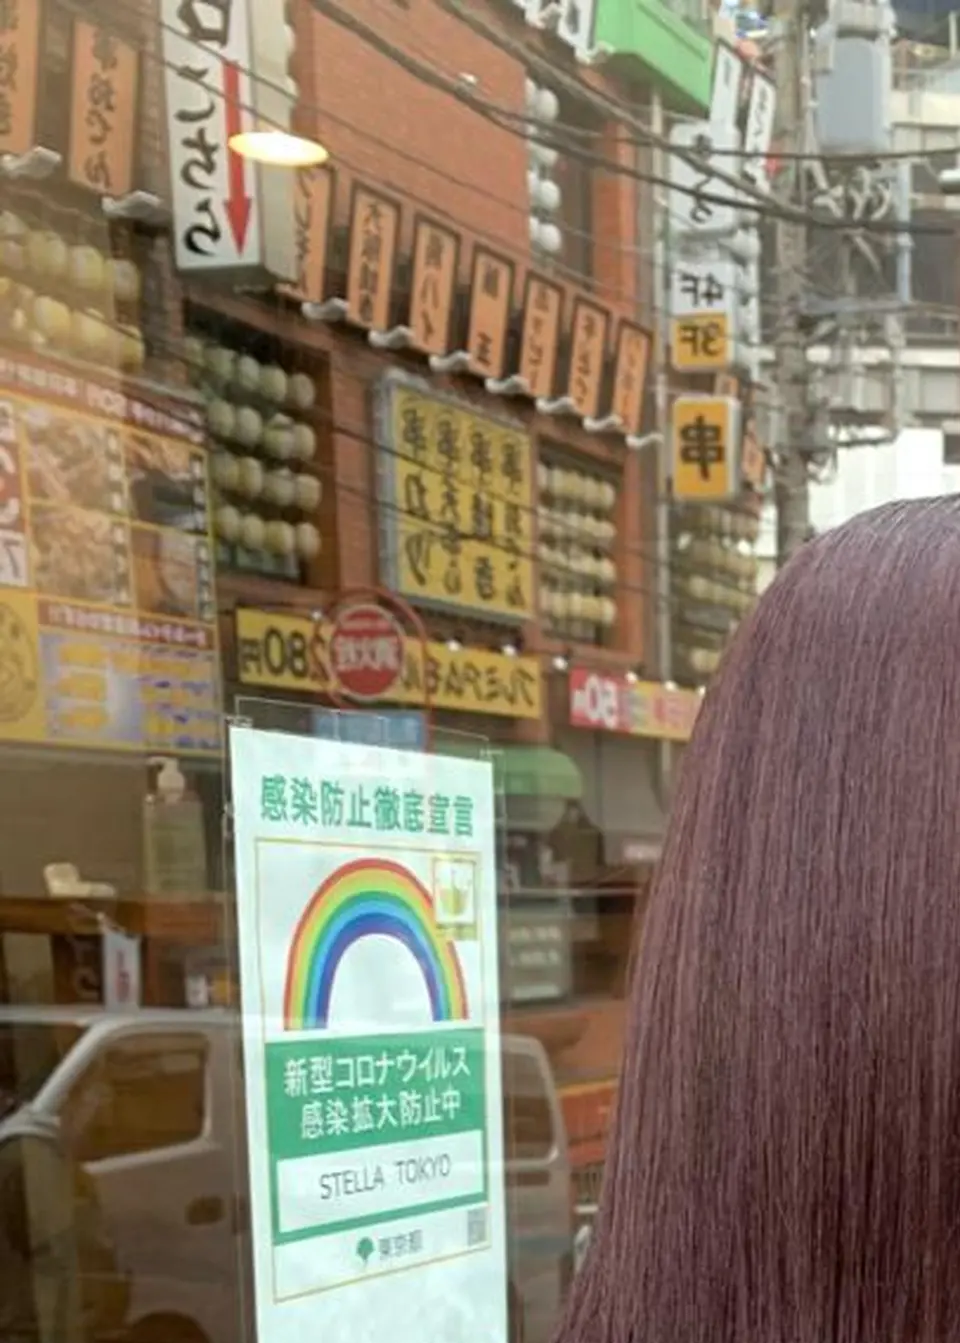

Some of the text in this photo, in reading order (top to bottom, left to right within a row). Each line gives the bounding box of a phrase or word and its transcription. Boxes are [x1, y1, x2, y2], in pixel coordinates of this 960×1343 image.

[261, 774, 474, 838] 感染防止徹底宣言
[284, 1046, 471, 1098] 新型コロナウイルス
[301, 1088, 462, 1140] 感染拡大防止中
[319, 1153, 452, 1201] STELLA TOKYO
[378, 1230, 423, 1260] 東京都
